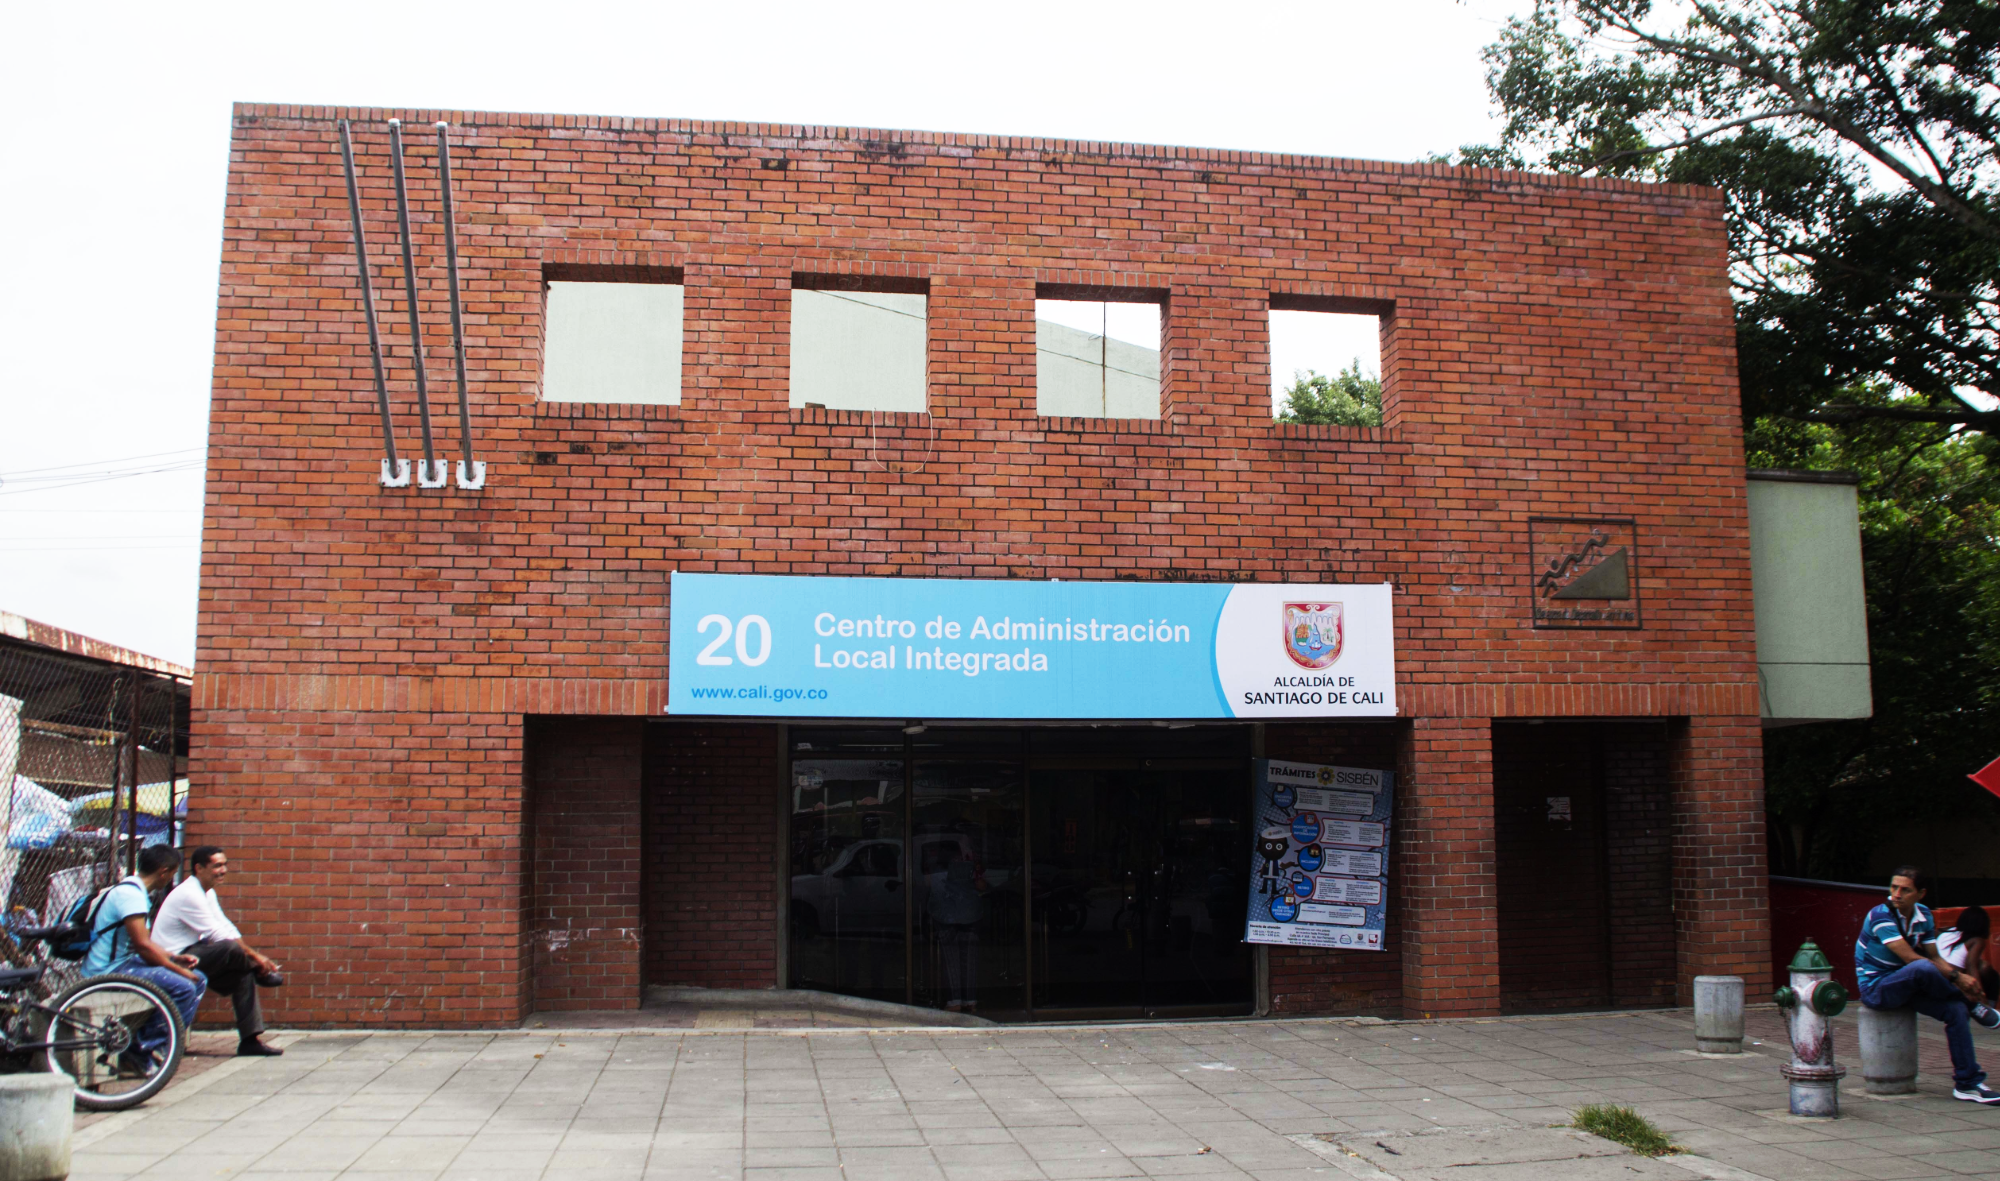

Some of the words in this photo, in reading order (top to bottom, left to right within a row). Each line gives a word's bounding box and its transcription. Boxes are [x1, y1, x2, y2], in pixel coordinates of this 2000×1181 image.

[814, 612, 917, 639] Centro
[924, 615, 962, 640] de
[969, 616, 1191, 643] Administración
[696, 614, 772, 667] 20
[814, 643, 896, 669] Local
[905, 644, 1049, 677] Integrada
[1273, 674, 1335, 688] ALCALDÍA
[1339, 677, 1355, 687] DE
[691, 685, 828, 702] www.cali.gov.co
[1244, 692, 1323, 705] SANTIAGO
[1328, 692, 1347, 704] DE
[1352, 692, 1384, 704] CALI
[1269, 766, 1316, 779] TRÁMITES
[1336, 771, 1379, 786] SISBÉN
